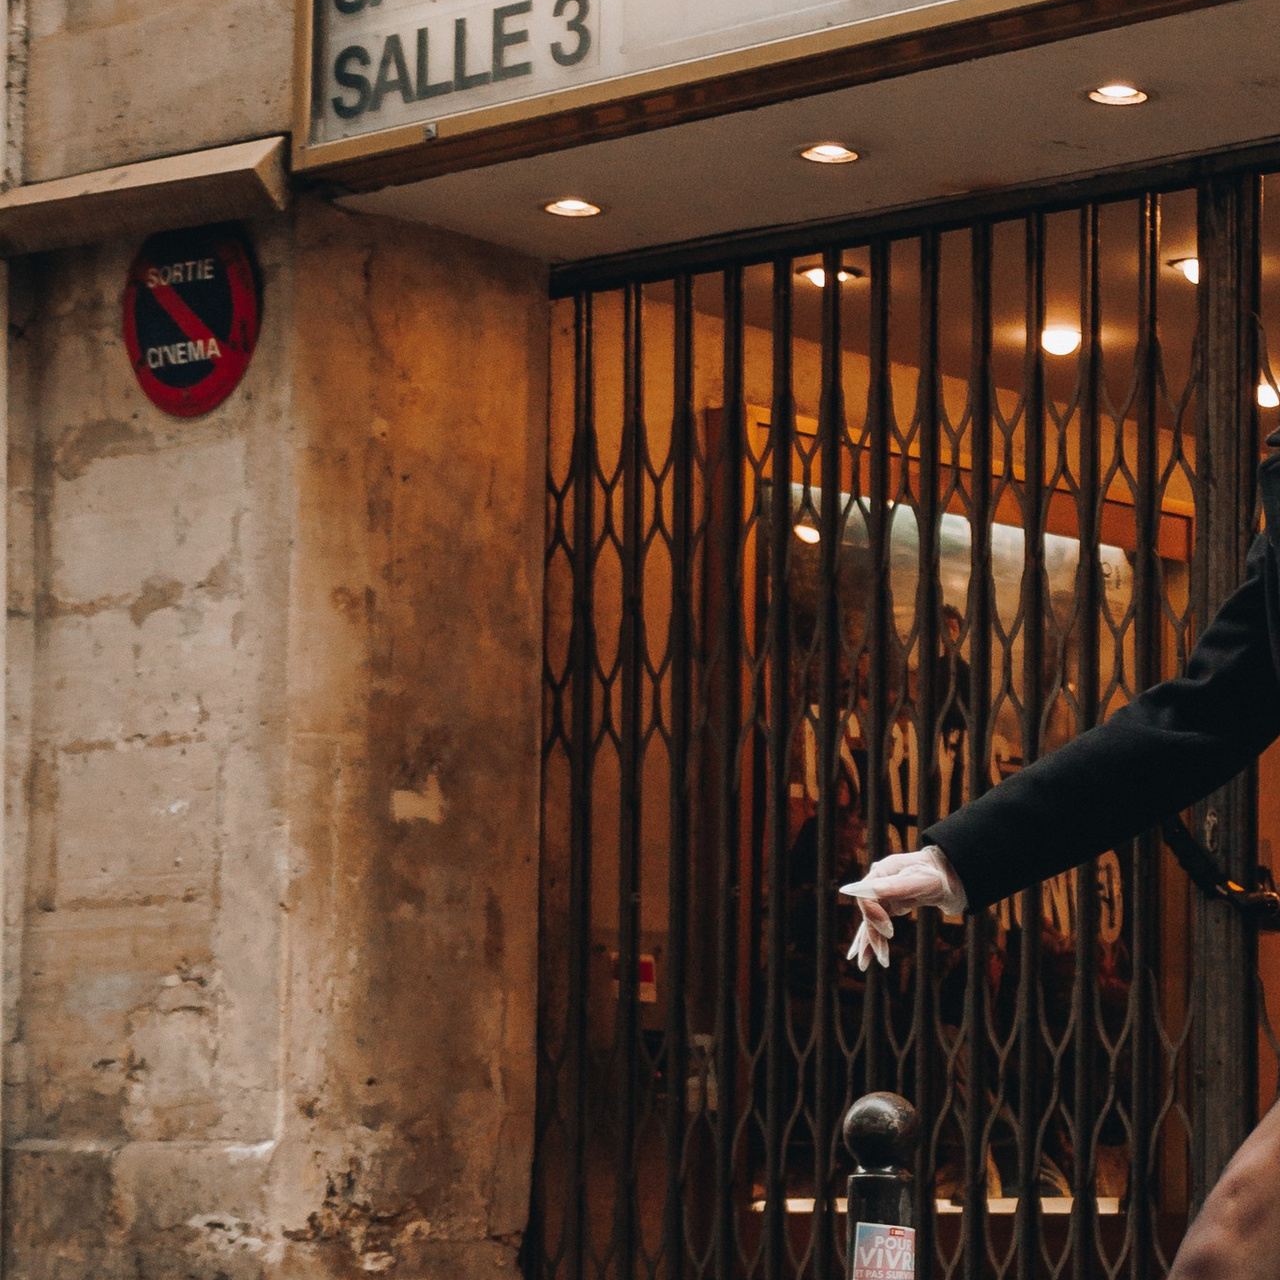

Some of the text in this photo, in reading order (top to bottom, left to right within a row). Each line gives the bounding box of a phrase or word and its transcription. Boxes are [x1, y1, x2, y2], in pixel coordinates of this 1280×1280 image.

[331, 0, 534, 121] SALLE
[147, 258, 215, 288] SORTIE
[146, 338, 222, 369] CINEMA
[874, 1235, 912, 1251] POUR
[859, 1247, 914, 1271] VIVR
[865, 1270, 884, 1279] PAS
